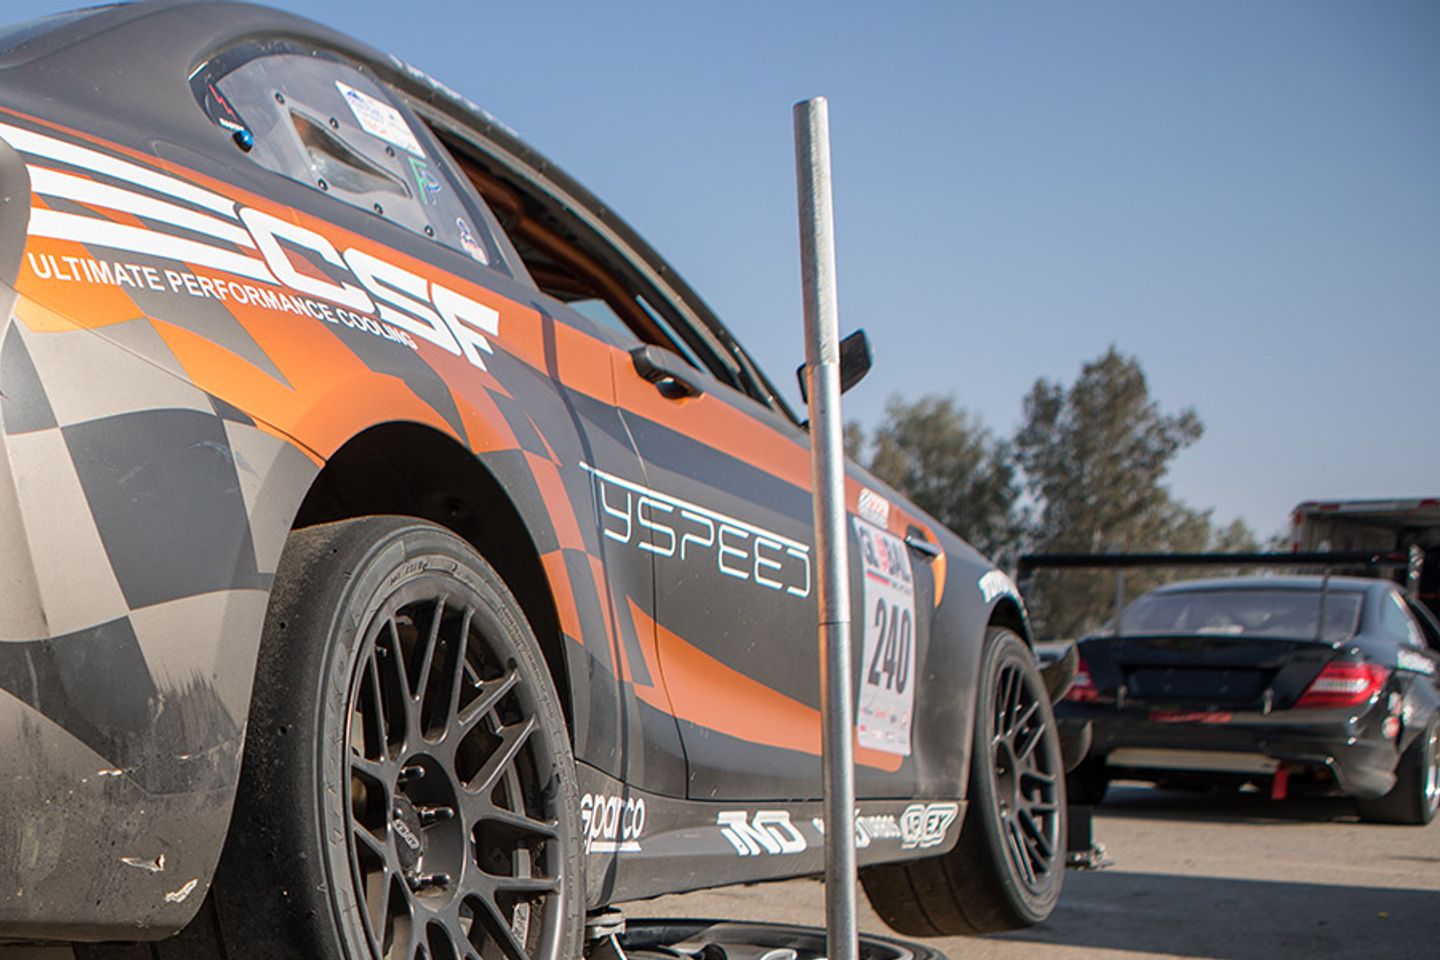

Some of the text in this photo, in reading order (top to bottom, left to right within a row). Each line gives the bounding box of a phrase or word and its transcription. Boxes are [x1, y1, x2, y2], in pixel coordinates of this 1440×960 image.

[27, 252, 419, 351] ULTIMATE PERFORMANCE COOLING
[234, 205, 500, 372] CSF
[867, 596, 911, 695] 240
